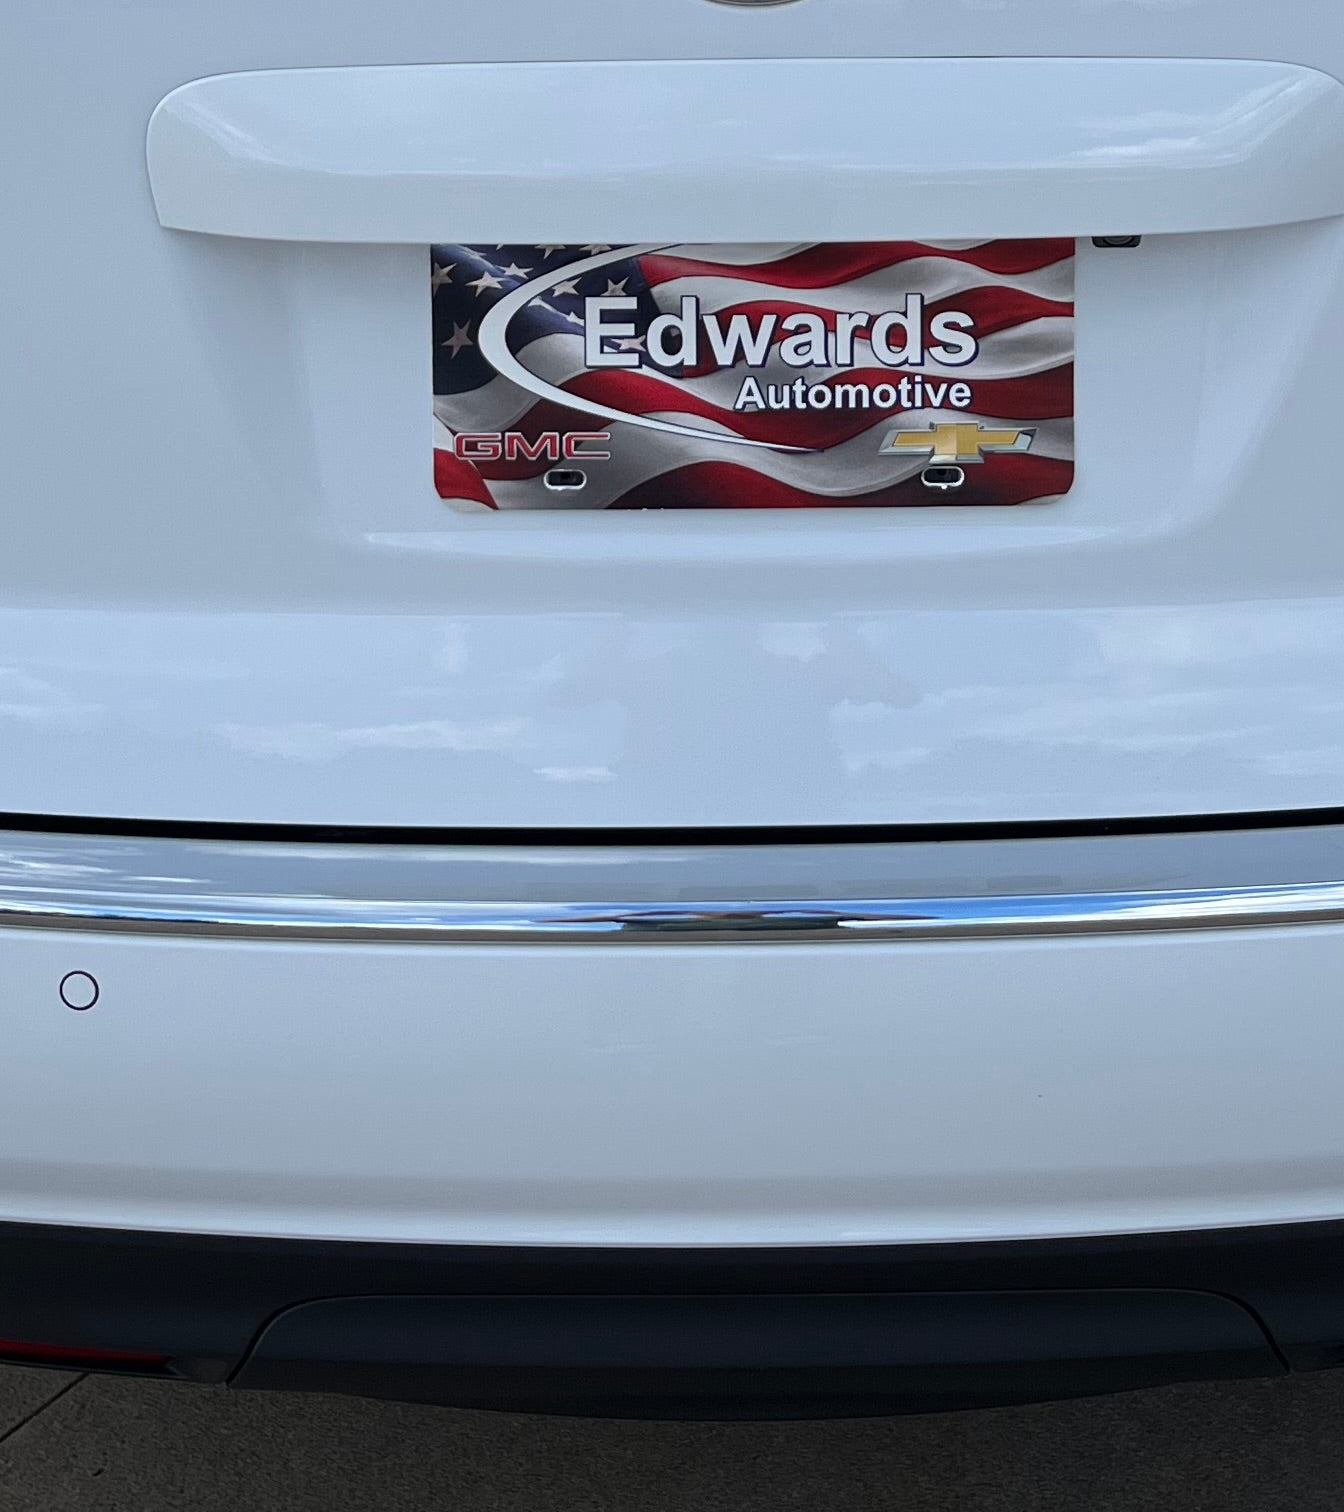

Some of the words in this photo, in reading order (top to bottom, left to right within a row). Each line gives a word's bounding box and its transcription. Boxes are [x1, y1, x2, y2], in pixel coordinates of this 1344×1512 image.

[582, 292, 978, 369] Edwards
[733, 375, 972, 412] Automotive
[454, 431, 611, 461] GMC
